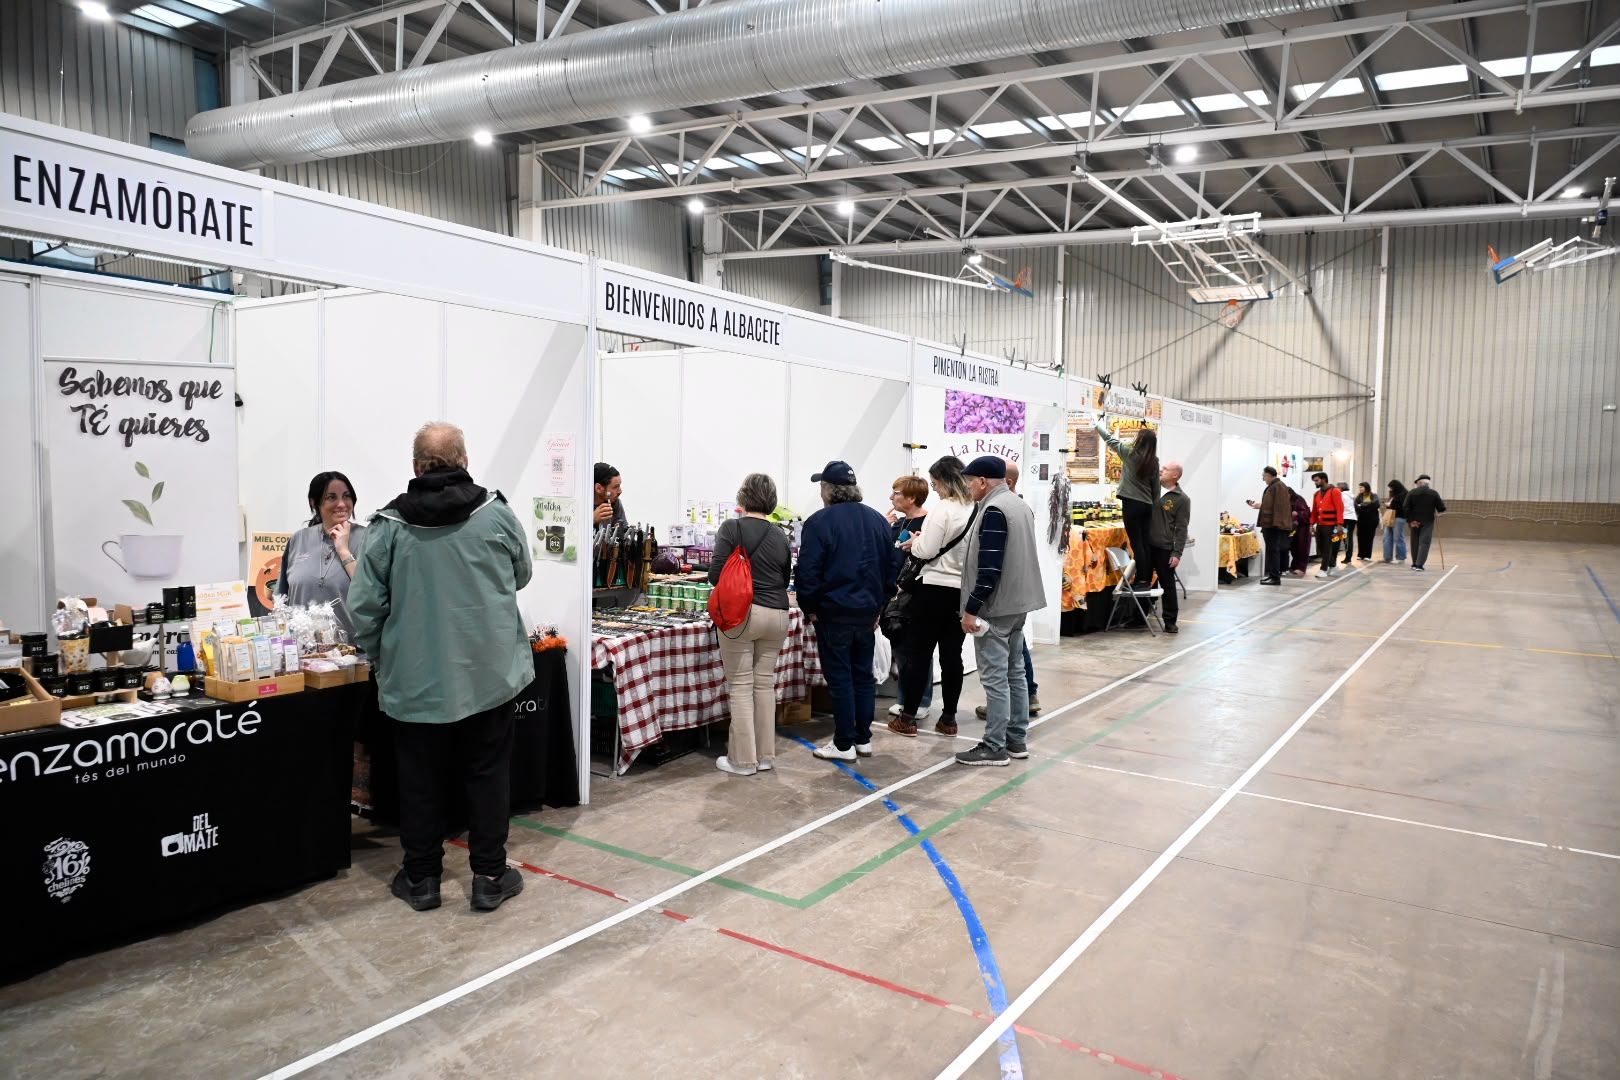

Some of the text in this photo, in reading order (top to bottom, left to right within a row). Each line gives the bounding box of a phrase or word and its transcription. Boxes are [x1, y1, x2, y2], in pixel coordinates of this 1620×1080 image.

[605, 281, 780, 346] BIENVENIDOS A ALBACETE
[933, 355, 999, 387] PIMENTON LA RISTRA
[58, 366, 223, 411] Sabemos que
[70, 402, 210, 448] TÉ quieres
[950, 438, 1020, 463] La Ristra
[254, 535, 274, 543] MIEL
[74, 752, 187, 784] tés del mundo
[192, 812, 212, 832] DEL
[184, 826, 219, 855] MATE
[53, 853, 80, 881] 16
[47, 876, 87, 893] chelines
